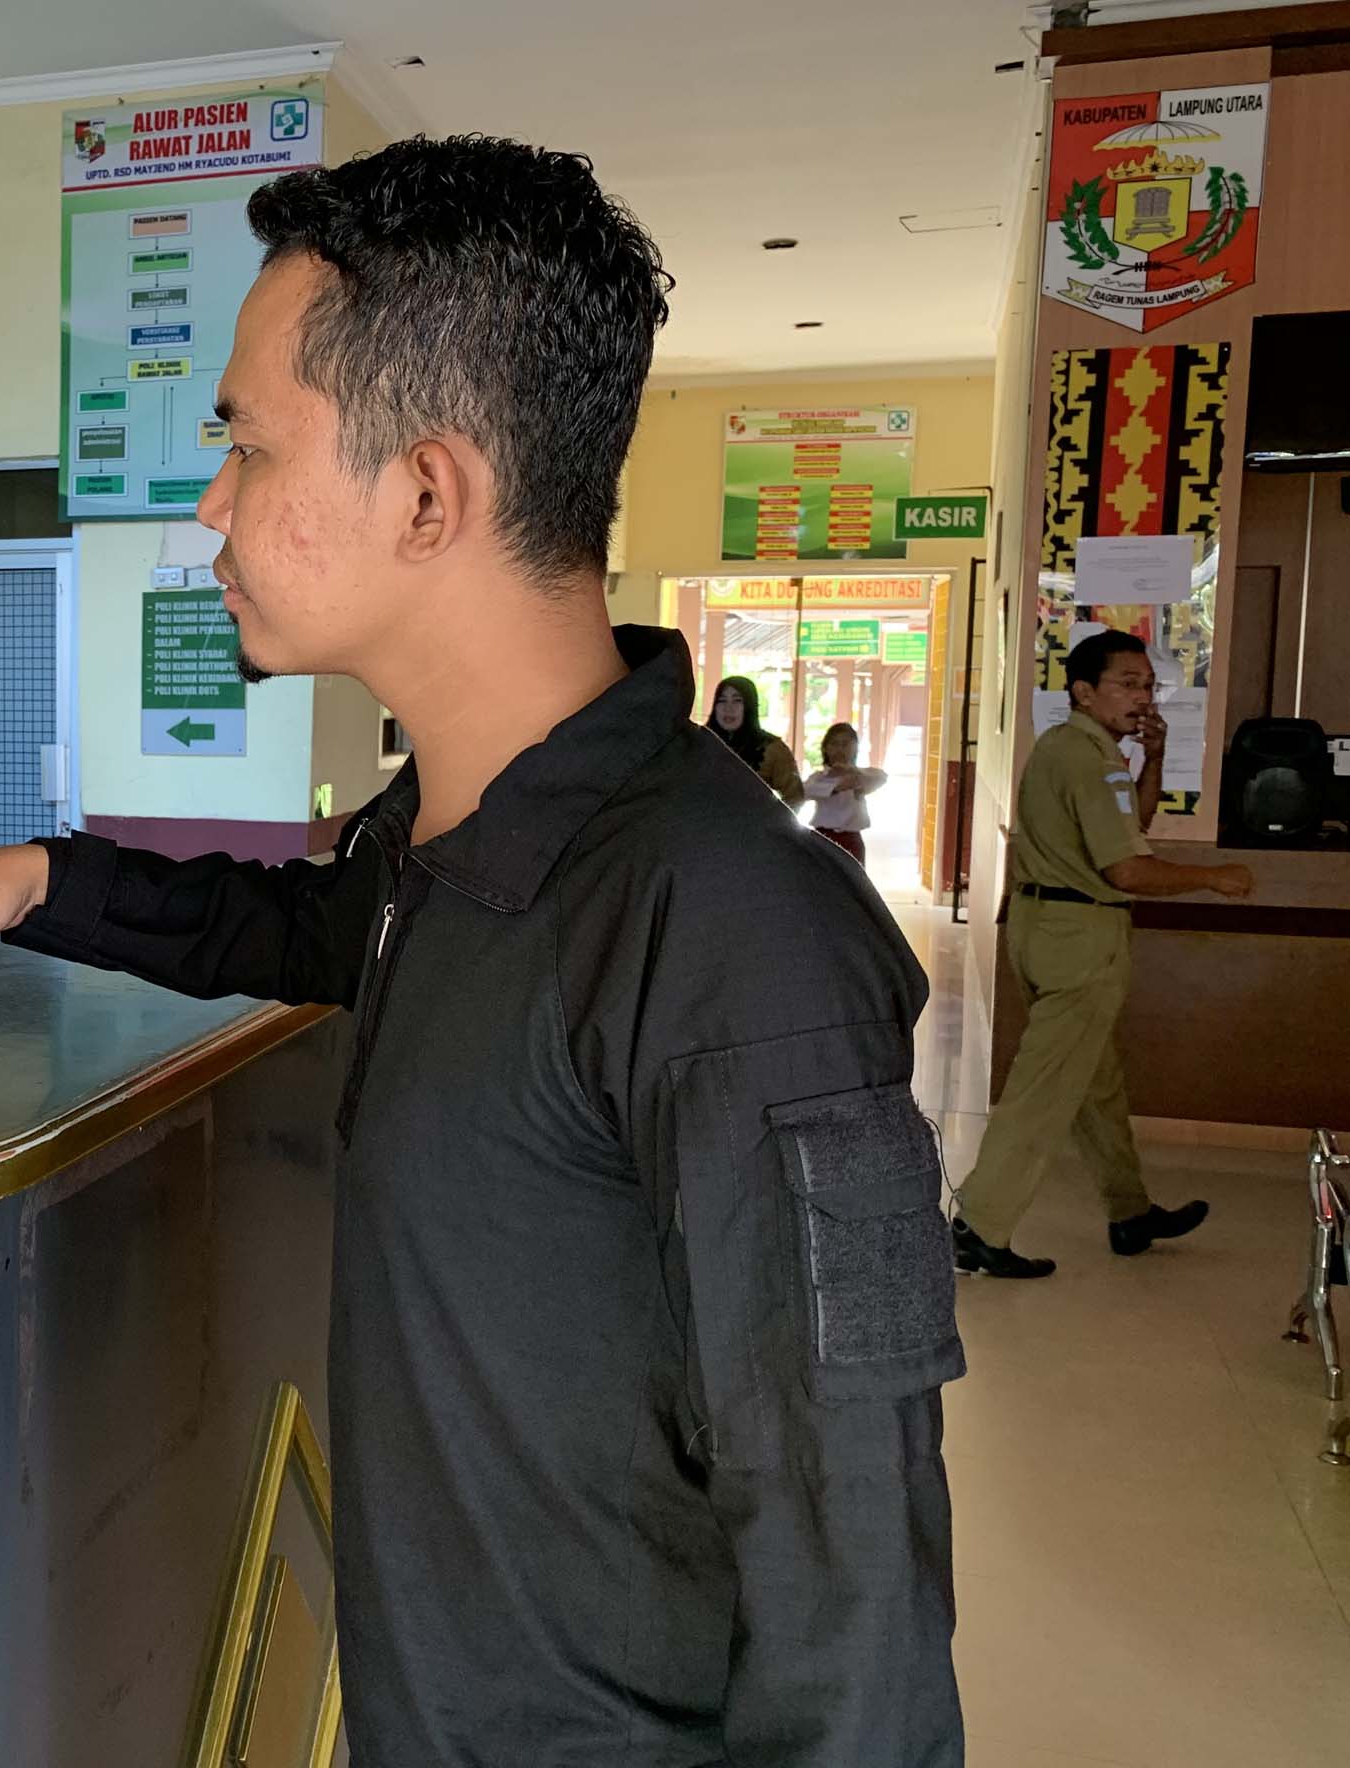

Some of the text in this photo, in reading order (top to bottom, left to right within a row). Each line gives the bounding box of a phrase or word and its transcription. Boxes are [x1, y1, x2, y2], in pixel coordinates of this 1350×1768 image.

[133, 101, 248, 134] ALUR PASIEN
[1063, 103, 1147, 127] KABUPATEN
[1168, 94, 1263, 118] LAMPUNG UTARA
[129, 128, 251, 162] RAWAT JALAN
[85, 169, 112, 180] UPTD.
[114, 167, 132, 178] RSD
[178, 160, 193, 172] HM
[195, 155, 240, 169] RYACUDU
[242, 150, 291, 166] KOTABUMI
[1093, 284, 1200, 306] RAGEM TUNAS LAMPUNG
[904, 506, 977, 529] KASIR
[740, 579, 922, 600] KITA DUUNG AKREDITASI
